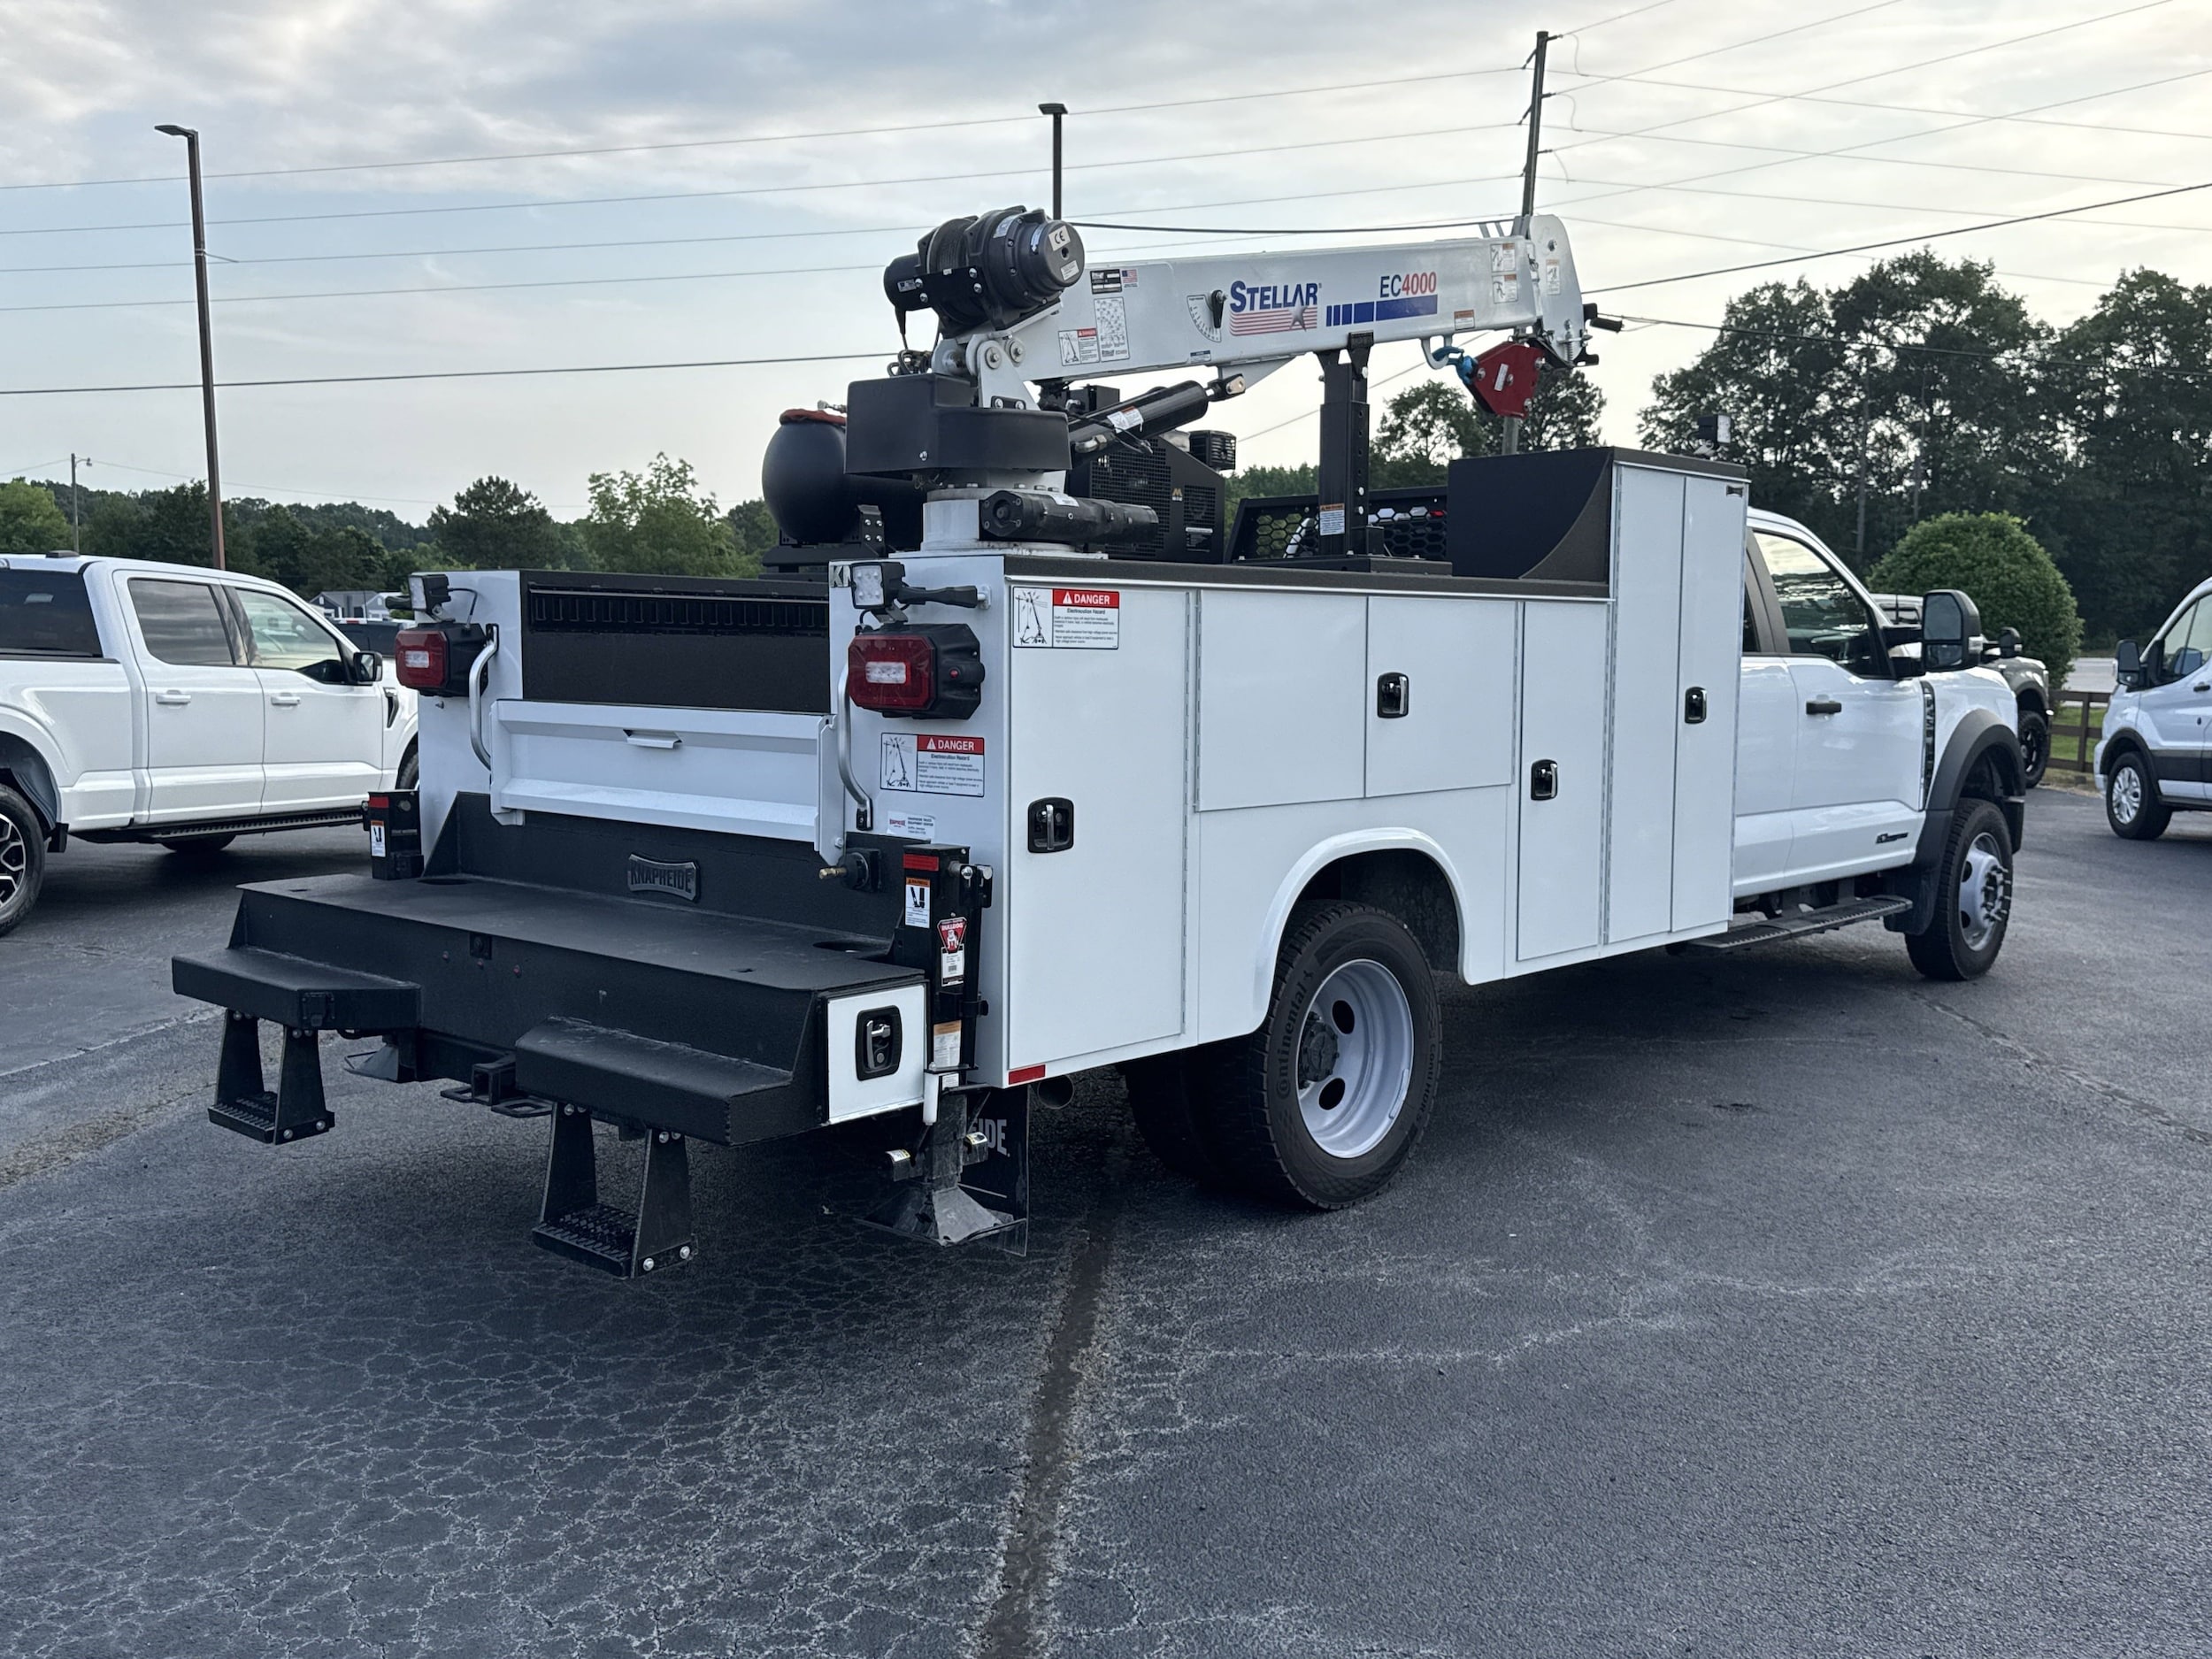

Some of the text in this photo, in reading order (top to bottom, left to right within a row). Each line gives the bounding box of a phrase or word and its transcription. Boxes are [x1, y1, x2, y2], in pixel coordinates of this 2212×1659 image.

[1379, 271, 1437, 299] EC4000
[1073, 593, 1110, 604] DANGER
[938, 740, 975, 751] DANGER
[630, 861, 693, 895] KNAPHEIDE
[1277, 983, 1308, 1097] Continental
